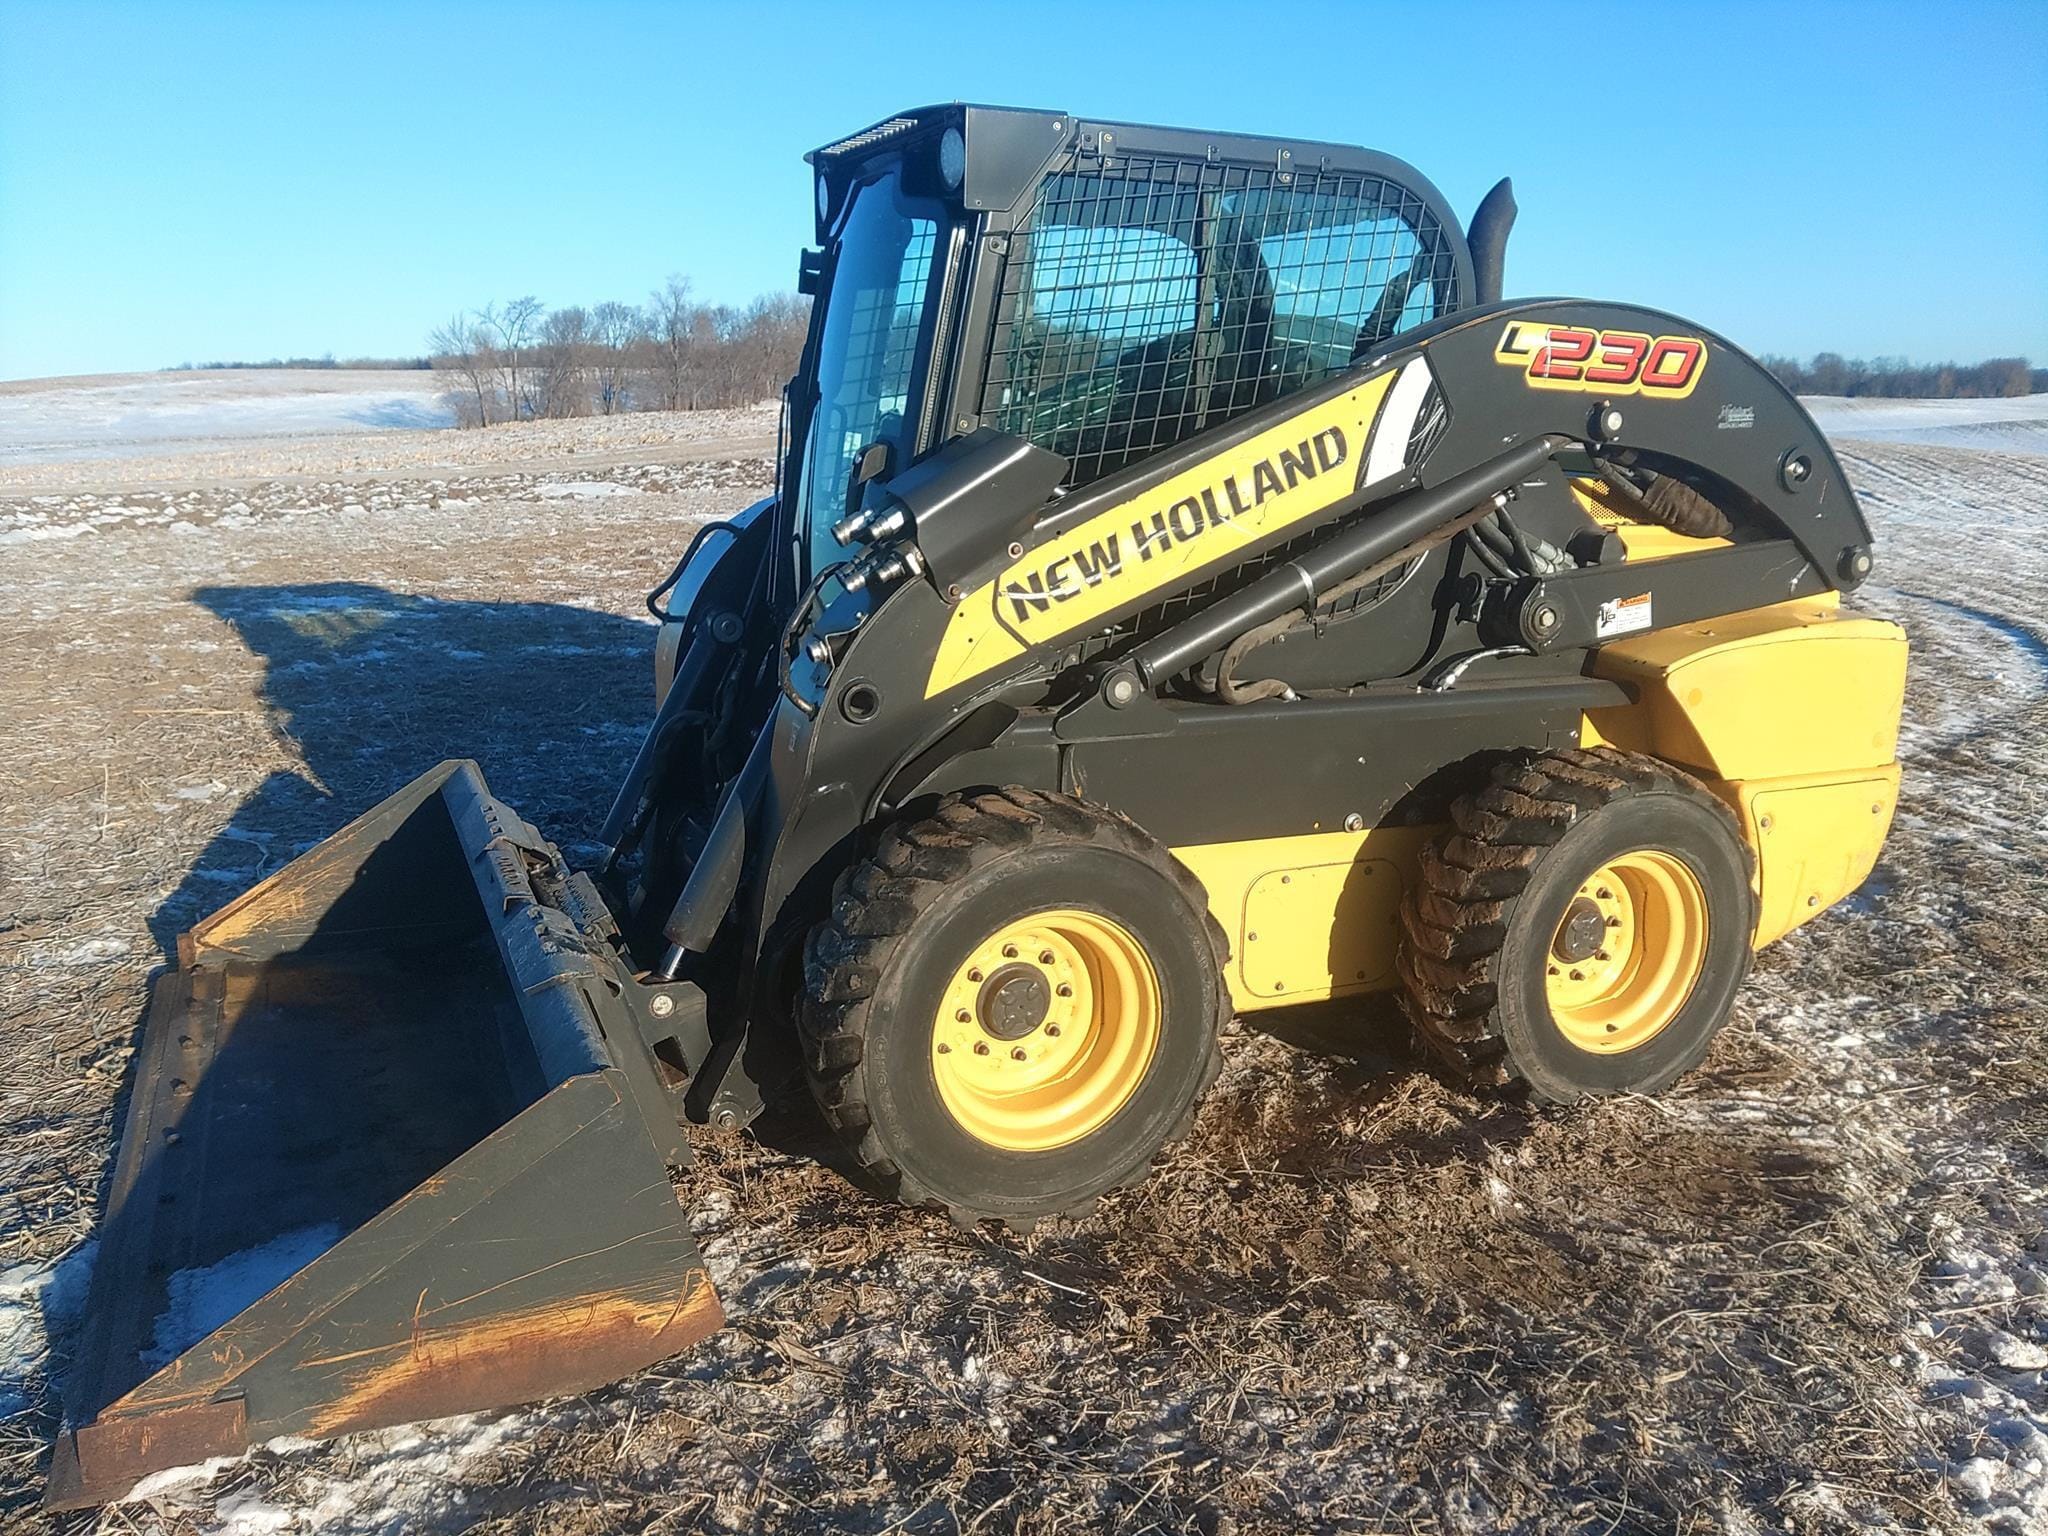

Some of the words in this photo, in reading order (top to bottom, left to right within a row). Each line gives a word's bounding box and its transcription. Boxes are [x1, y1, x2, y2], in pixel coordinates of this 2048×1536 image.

[1498, 325, 1703, 389] L230
[1005, 532, 1123, 623] NEW
[1130, 425, 1348, 563] HOLLAND
